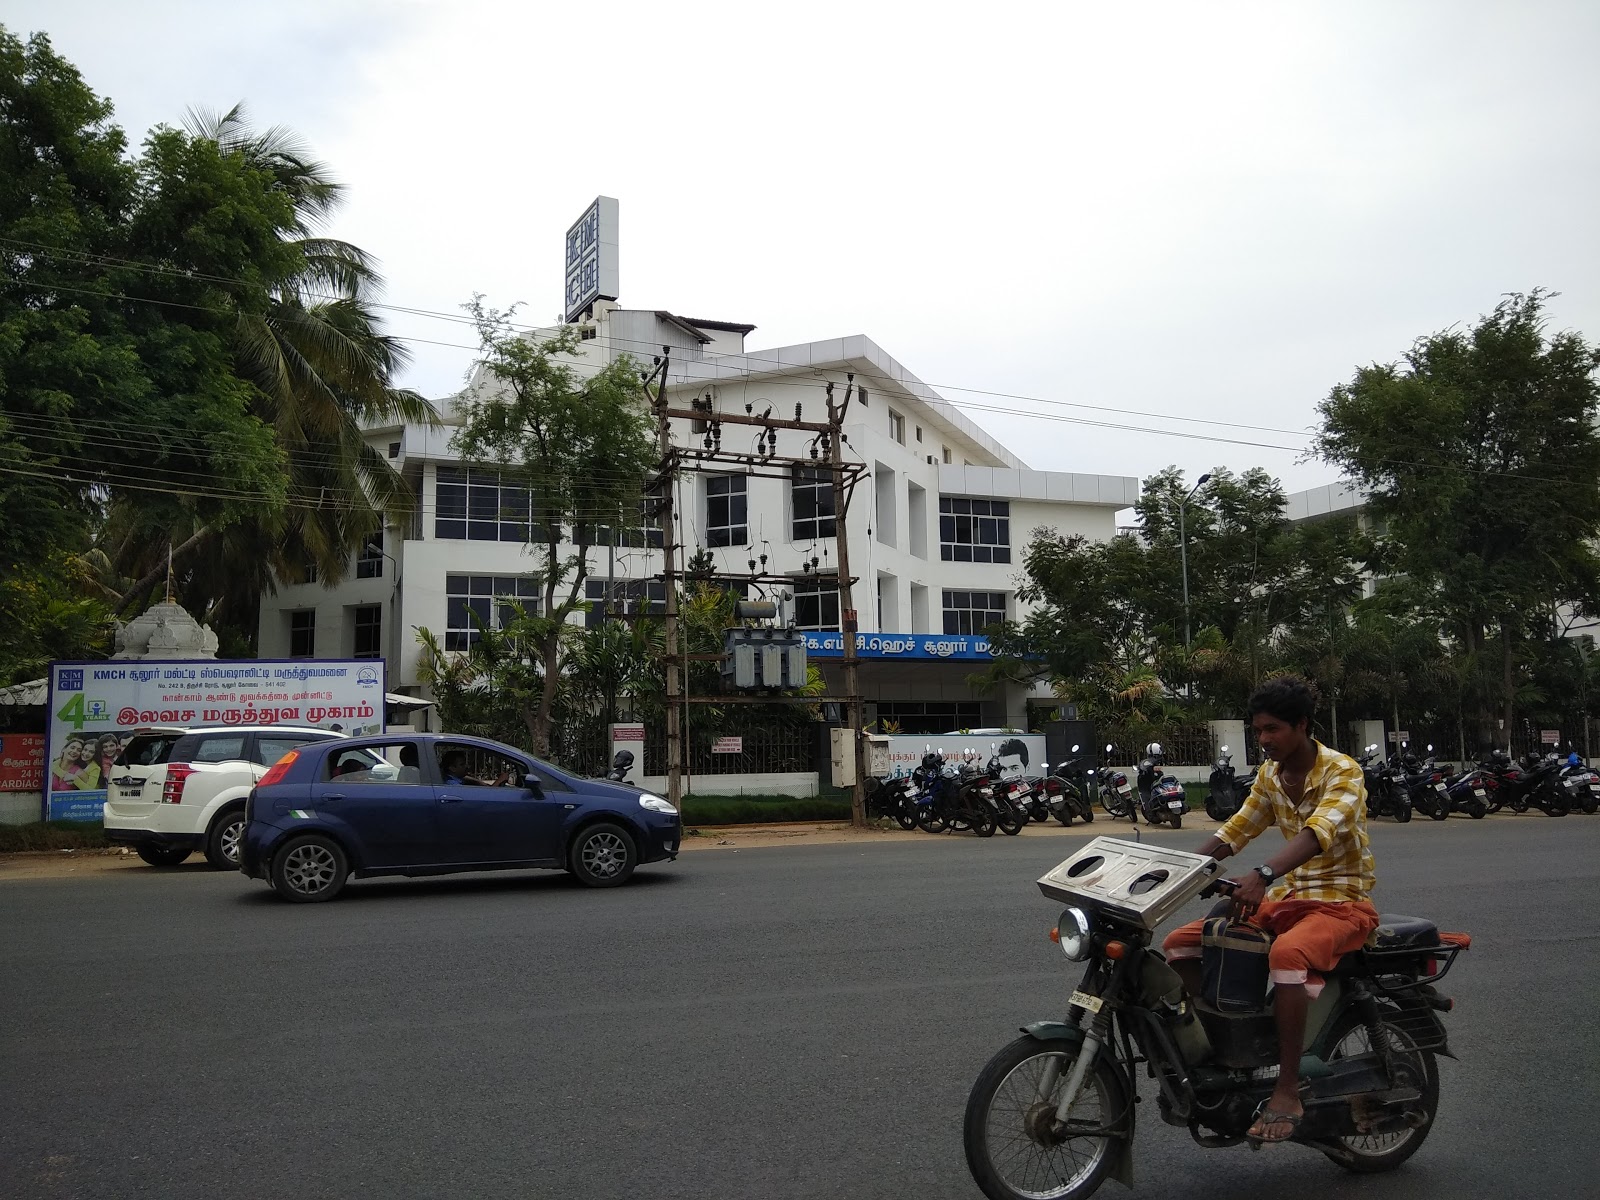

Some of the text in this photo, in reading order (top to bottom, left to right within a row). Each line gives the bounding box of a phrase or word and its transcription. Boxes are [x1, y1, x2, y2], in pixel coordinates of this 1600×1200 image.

[800, 635, 915, 655] கே.எம்சி.ஹெச்
[94, 670, 126, 680] KMCH
[129, 668, 160, 682] சூலூர்
[274, 666, 348, 681] மருத்துவமனை
[56, 693, 85, 730] 4
[116, 700, 374, 726] இலவச மருத்துவ முகாம்
[22, 738, 33, 746] 24
[21, 770, 32, 778] 24
[0, 780, 39, 788] ARDIAC
